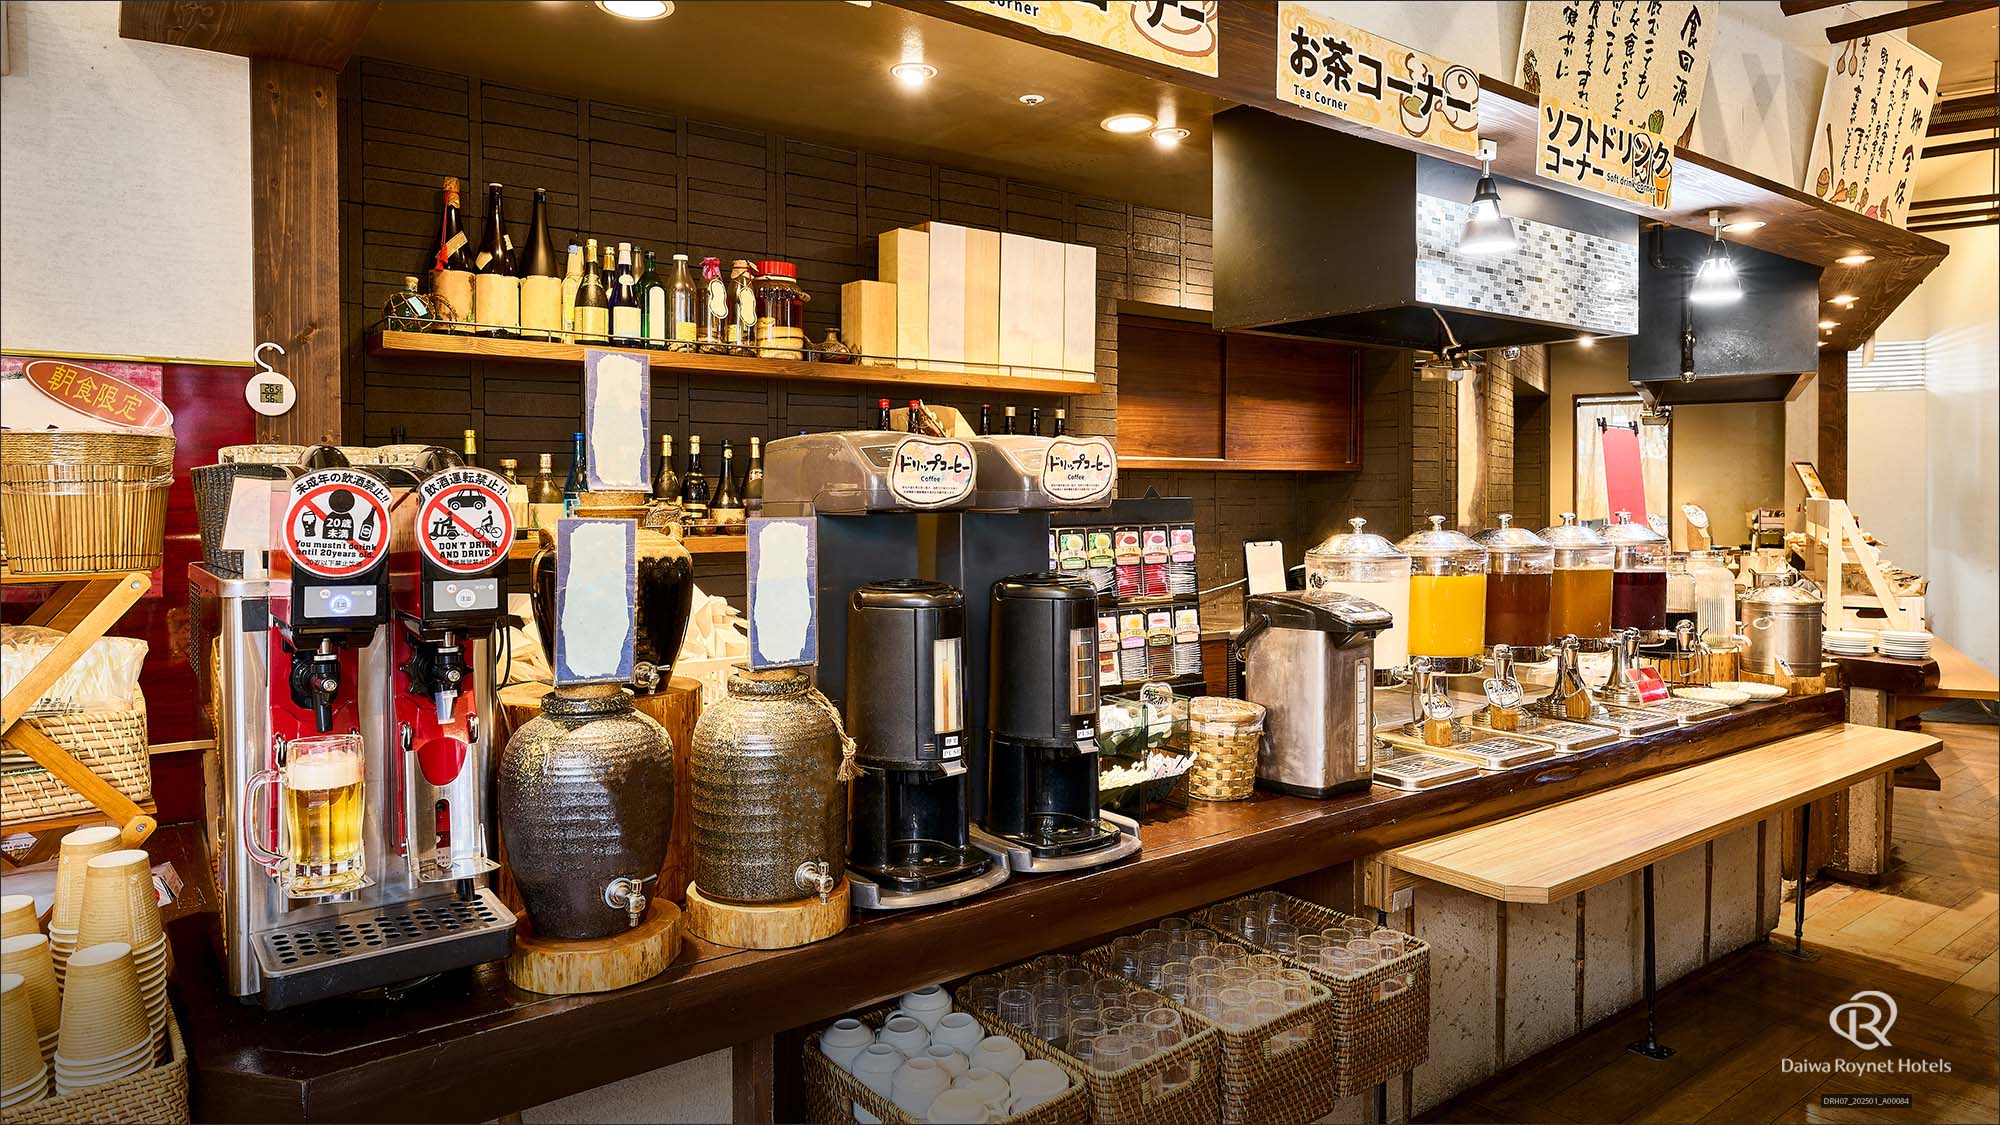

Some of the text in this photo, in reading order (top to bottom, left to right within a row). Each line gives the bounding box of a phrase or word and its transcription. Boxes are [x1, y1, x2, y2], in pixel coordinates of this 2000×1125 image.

[989, 0, 1040, 17] orner
[1290, 26, 1472, 116] お茶コーナー
[1293, 84, 1348, 112] Tea Corner
[1546, 106, 1669, 175] ソフトドリンク
[1546, 145, 1604, 181] コーナー
[1606, 172, 1619, 185] Soft
[47, 365, 143, 421] 朝食限定
[900, 453, 970, 473] ドリップコーヒー
[1050, 453, 1110, 472] ドリップコーヒー
[326, 519, 352, 529] 20歳
[327, 529, 350, 539] 未満
[295, 540, 311, 548] You
[439, 540, 498, 550] DON'T DRINK
[296, 548, 318, 556] until
[320, 549, 356, 558] 20years
[439, 550, 459, 558] AND
